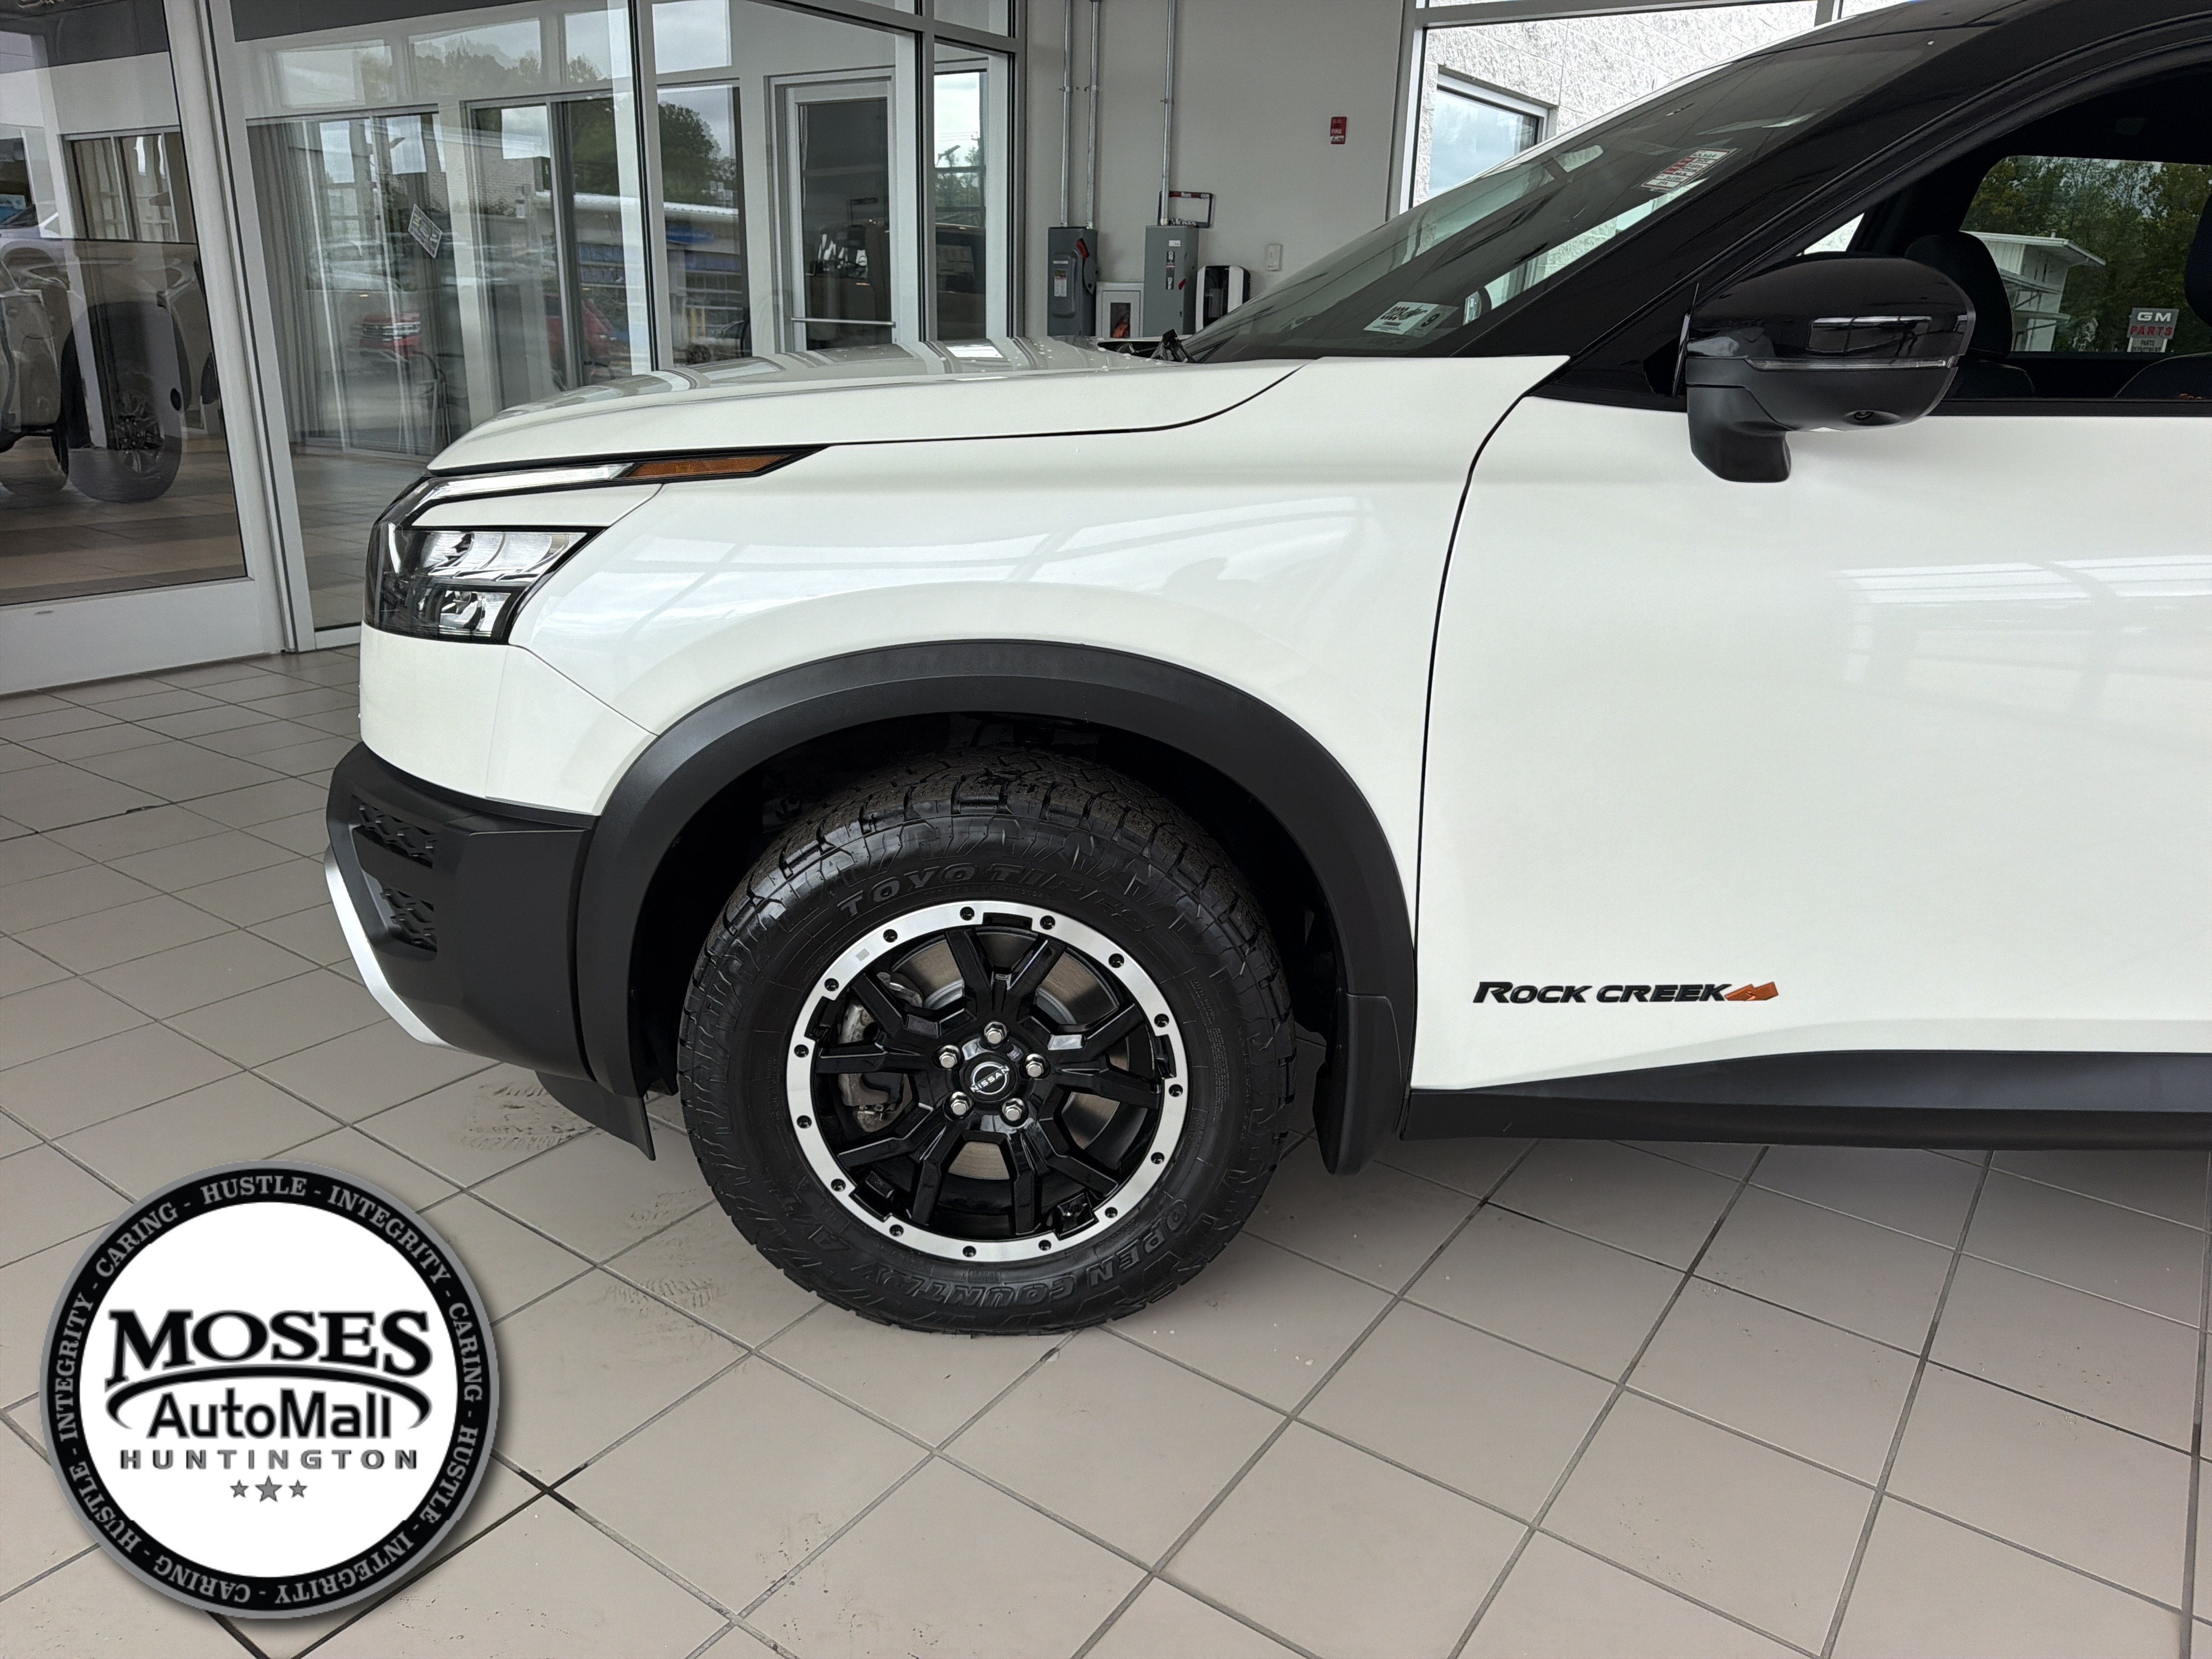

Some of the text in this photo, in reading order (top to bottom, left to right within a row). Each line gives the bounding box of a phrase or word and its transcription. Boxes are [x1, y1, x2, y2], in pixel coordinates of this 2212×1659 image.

[2130, 325, 2173, 336] PARTS
[2137, 312, 2172, 323] GM
[837, 862, 978, 918] TOYO
[1472, 981, 1733, 1003] ROCK CREEK
[970, 1065, 1009, 1092] NISSAN
[1086, 1199, 1188, 1288] OPEN
[850, 1261, 1076, 1309] COUNTRY
